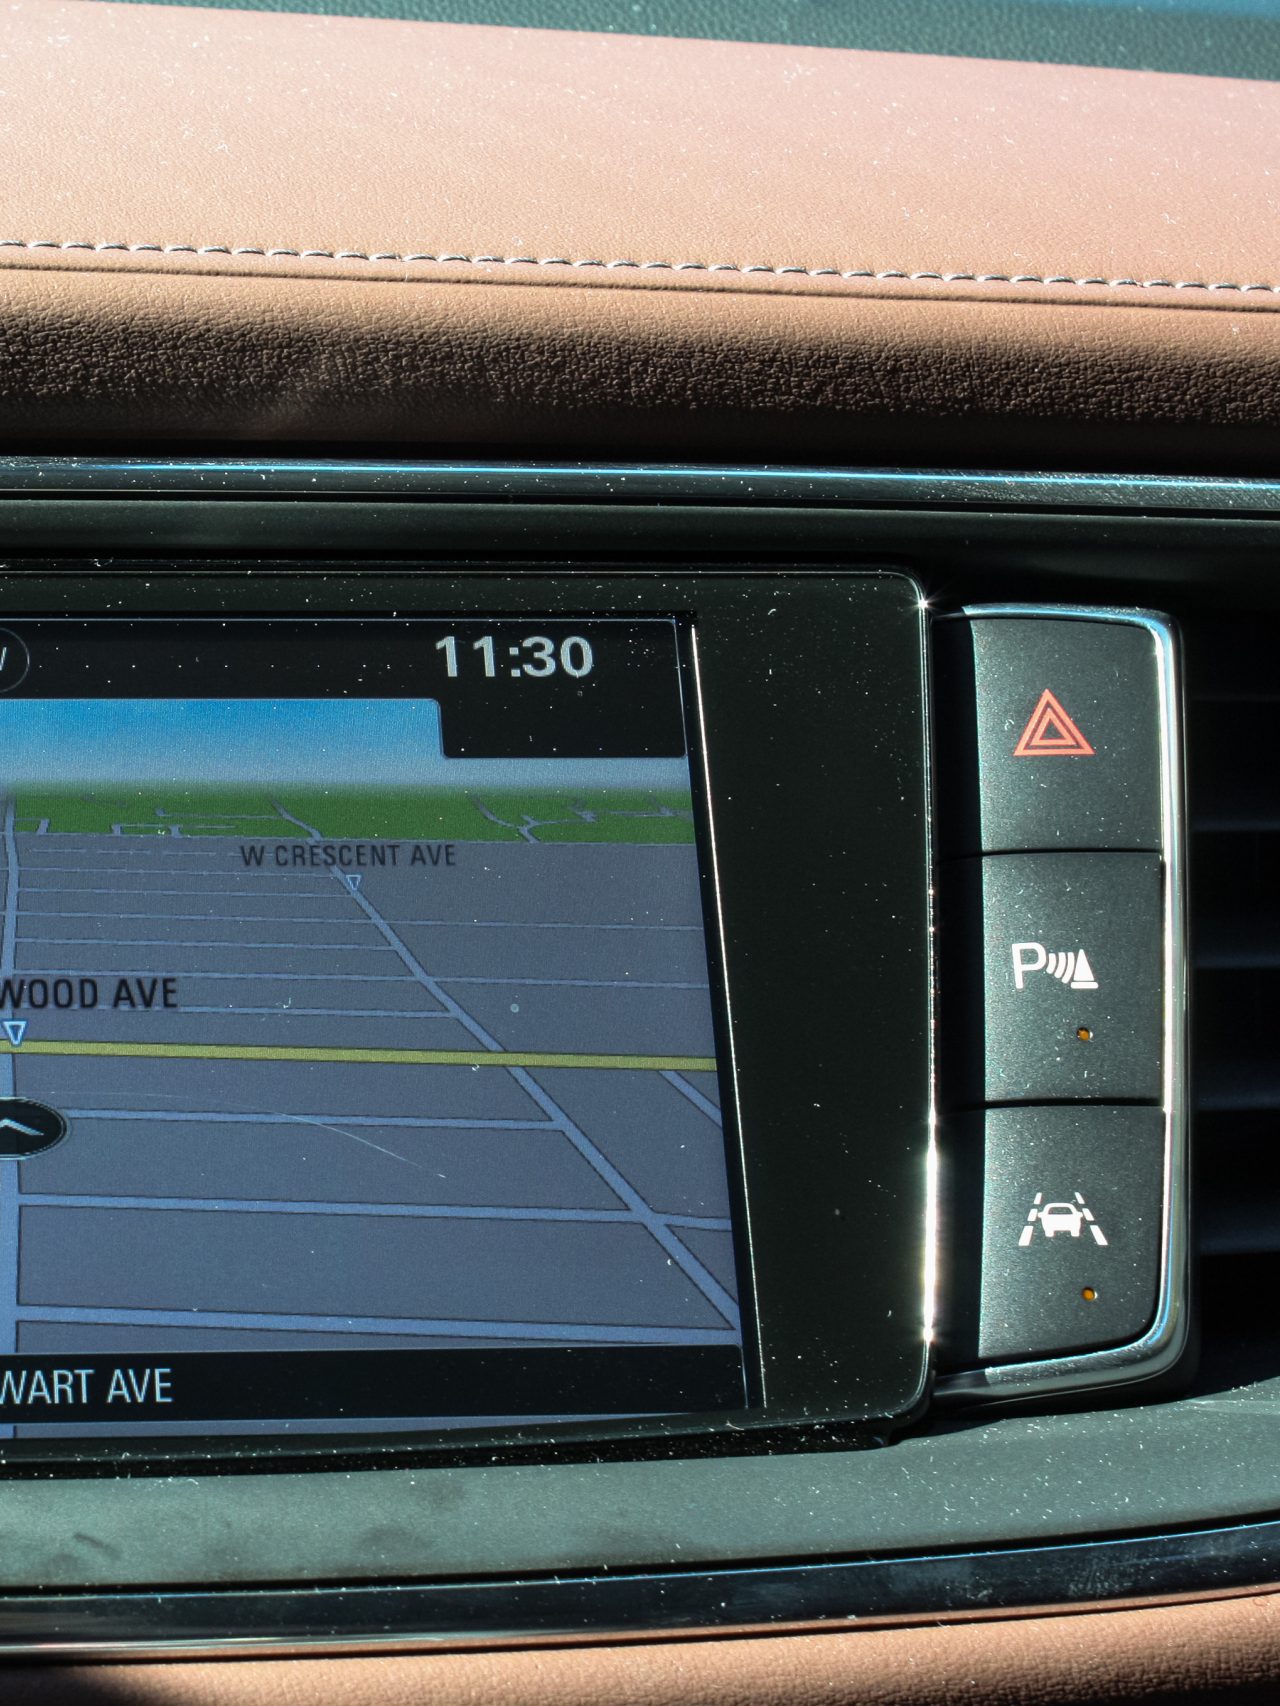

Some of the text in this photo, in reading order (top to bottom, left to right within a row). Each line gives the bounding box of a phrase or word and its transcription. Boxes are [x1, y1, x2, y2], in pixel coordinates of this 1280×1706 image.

[435, 636, 595, 678] 11:30
[240, 844, 457, 866] W CRESCENT AVE
[113, 979, 179, 1008] AVE
[106, 1368, 174, 1404] AVE
